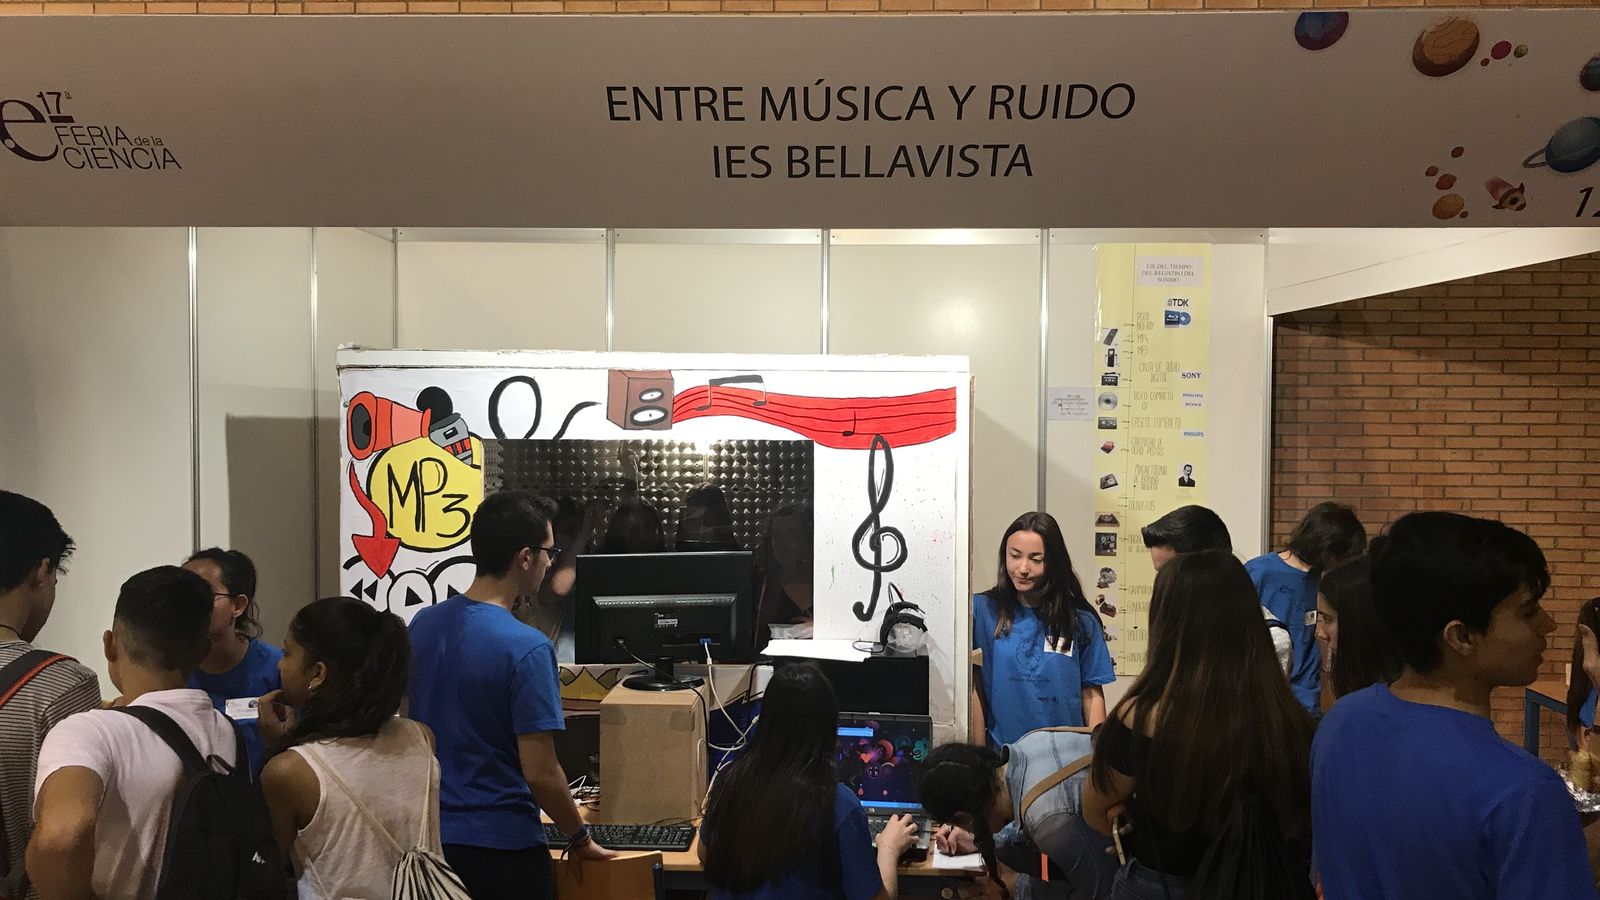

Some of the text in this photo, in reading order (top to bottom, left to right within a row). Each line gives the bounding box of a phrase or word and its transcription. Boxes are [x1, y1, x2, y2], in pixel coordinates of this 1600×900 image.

[605, 78, 1136, 122] ENTRE MÚSICA Y RUIDO
[54, 125, 164, 146] FERIA de la
[62, 147, 183, 170] CIENCIA
[712, 143, 1034, 179] IES BELLAVISTA
[1172, 298, 1189, 307] TDK
[1181, 372, 1202, 380] SONY
[387, 457, 471, 538] MP3
